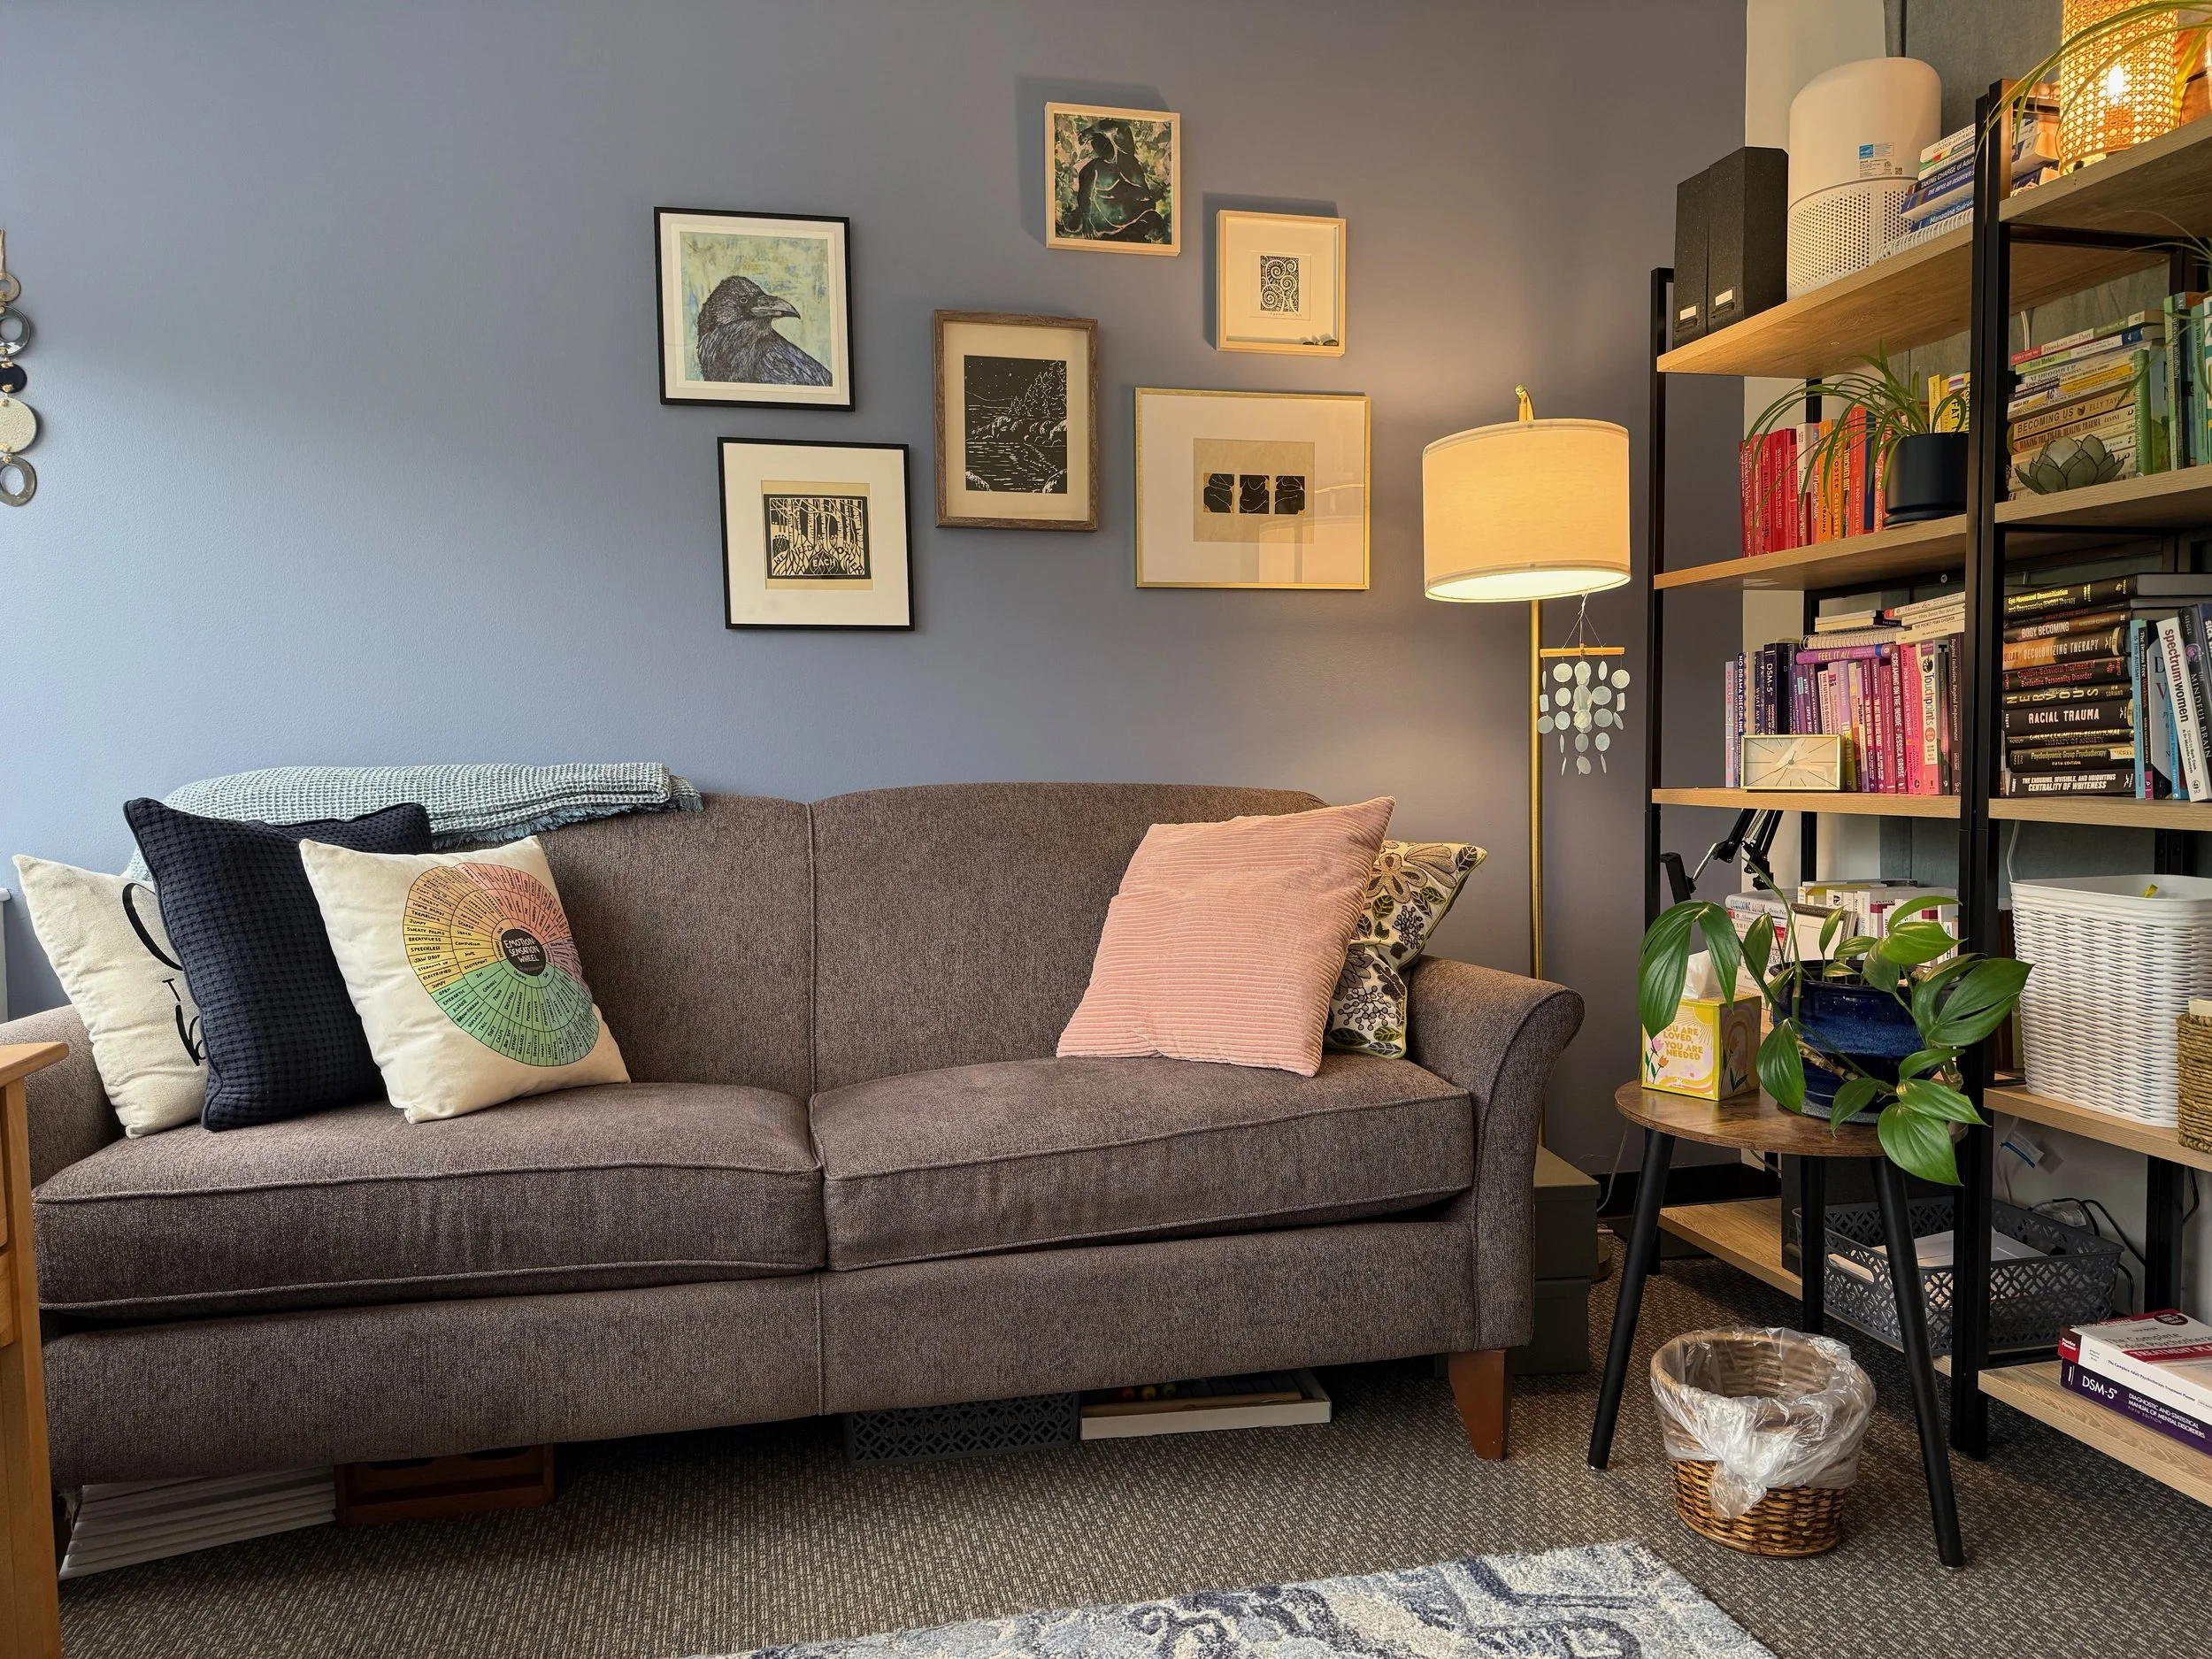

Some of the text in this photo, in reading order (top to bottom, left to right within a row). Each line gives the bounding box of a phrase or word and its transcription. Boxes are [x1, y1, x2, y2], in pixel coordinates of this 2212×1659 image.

[1921, 165, 1955, 188] TAKING CHARGE
[1930, 208, 1955, 224] Managing
[2025, 375, 2059, 388] Low-Demand
[2017, 402, 2103, 434] BECOMING US ELLY
[2082, 418, 2101, 431] TRAUMA
[1778, 490, 1782, 499] ON
[774, 545, 813, 565] WE NEED
[2021, 628, 2037, 639] BODY
[2038, 621, 2070, 635] BECOMING
[1818, 652, 1832, 661] FEEL
[1840, 650, 1850, 659] ALL
[2024, 639, 2099, 659] DECOLONIZING THERAPY
[1829, 673, 1837, 687] Bi
[2021, 672, 2093, 687] Borderline Personality Disorder
[1923, 673, 1935, 726] Touchpoints
[2007, 688, 2099, 704] NERVOUS
[1755, 710, 1760, 720] MY
[2029, 709, 2100, 724] RACIAL TRAUMA
[2191, 673, 2211, 758] MINDFUL BRAIN
[1841, 720, 1850, 734] THE
[2028, 783, 2062, 792] CENTRALITY
[411, 910, 441, 922] TREMBLING
[509, 946, 540, 956] SENSATION
[465, 959, 488, 970] EXCITEMENT
[423, 969, 451, 979] ELECTRIFIED
[514, 971, 526, 980] HAPPY
[482, 979, 497, 992] CURIOUS
[442, 989, 466, 1005] ENERGETIC
[556, 992, 570, 1013] DEPRESSED
[453, 999, 467, 1013] AWAKE
[546, 998, 556, 1023] APATHETIC
[468, 1011, 482, 1027] INFLATED
[479, 1022, 488, 1031] TALL
[488, 1026, 496, 1037] SOFT
[1663, 1032, 1694, 1043] LOVED,
[1666, 1049, 1701, 1060] NEEDED
[1686, 1045, 1703, 1054] ARE
[2128, 1333, 2182, 1343] Complete
[2129, 1348, 2194, 1356] TREATMENT
[2115, 1363, 2131, 1372] Complete
[2139, 1374, 2165, 1389] Psychotherapy
[2164, 1386, 2182, 1396] Treatment
[2182, 1393, 2196, 1402] Planner
[2127, 1406, 2162, 1425] FIFTH EDITION
[2128, 1393, 2200, 1429] DIAGNOSTIC AND STATISTICAL
[2128, 1400, 2206, 1439] MANUAL OF MENTAL DISORDERS
